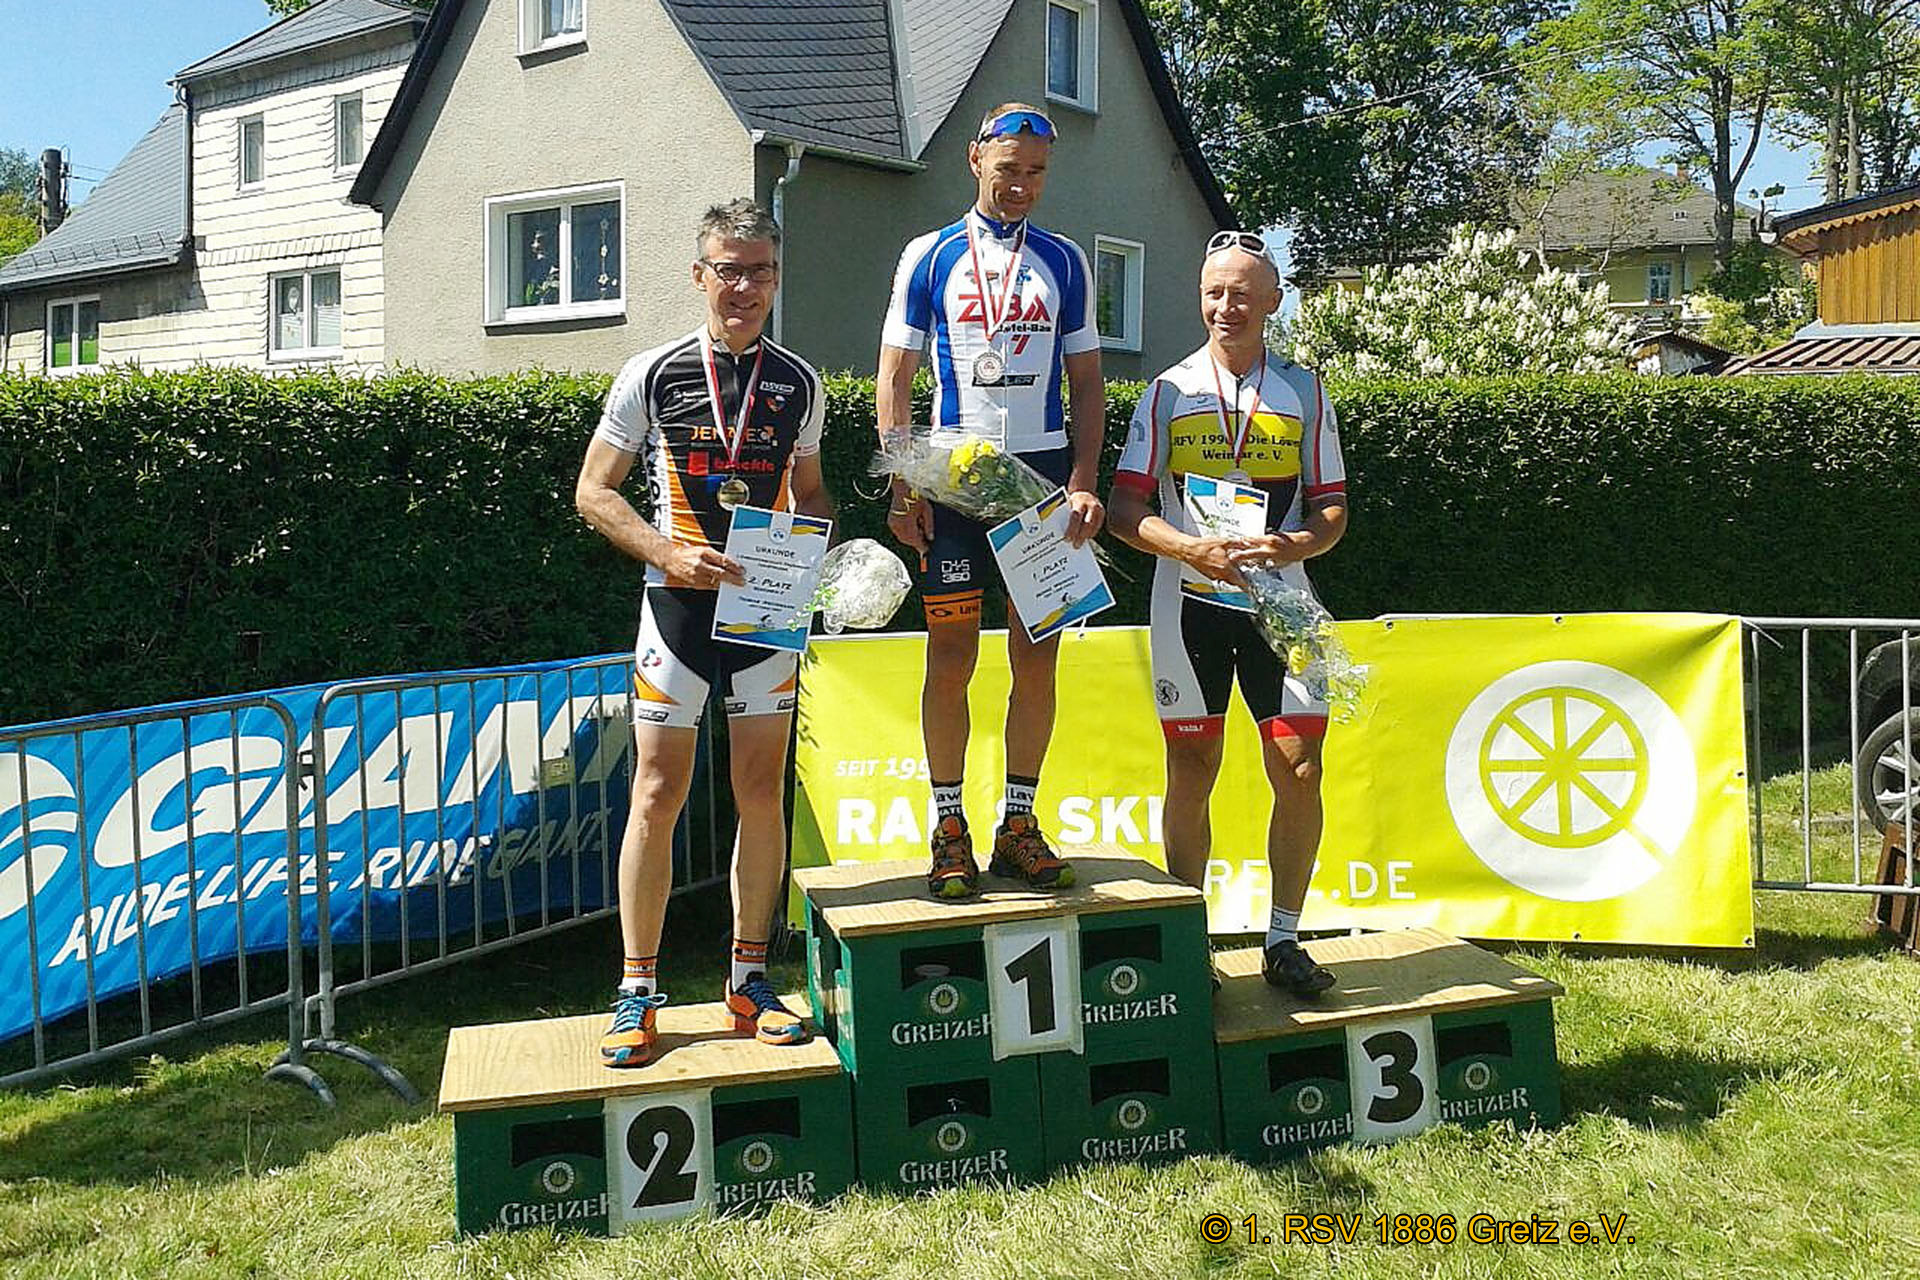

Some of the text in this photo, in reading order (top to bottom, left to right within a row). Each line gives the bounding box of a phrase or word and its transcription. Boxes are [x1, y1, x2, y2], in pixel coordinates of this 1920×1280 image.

[884, 757, 930, 780] 199
[49, 869, 193, 967] RIDE
[349, 836, 492, 890] RIDE
[1005, 937, 1057, 1036] 1
[1362, 1030, 1424, 1123] 3
[627, 1105, 698, 1209] 2
[900, 1149, 1008, 1184] GREIZER
[1082, 1127, 1187, 1160] GREIZER
